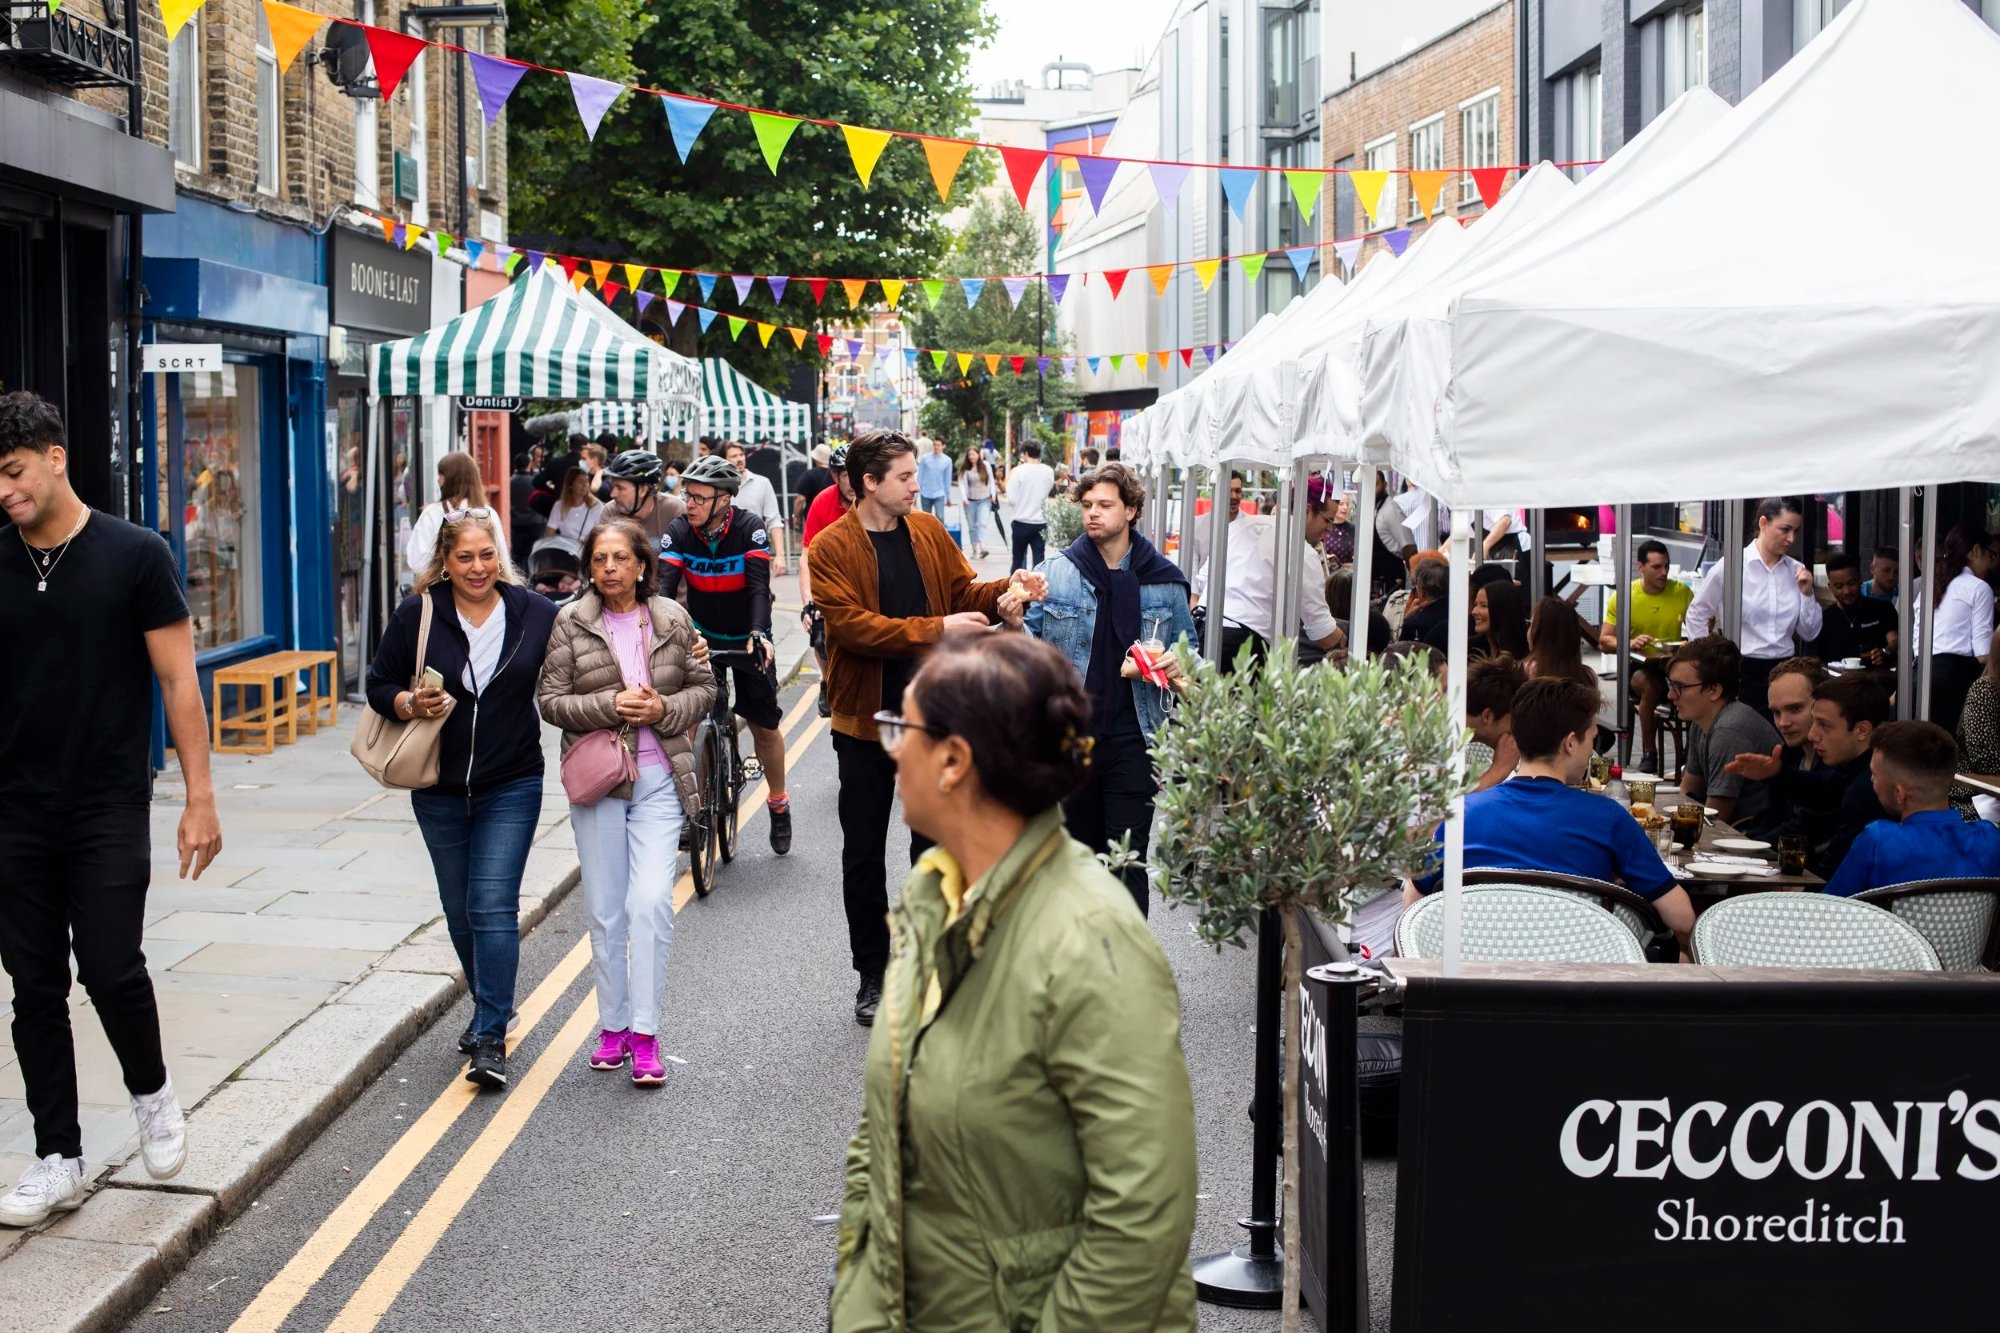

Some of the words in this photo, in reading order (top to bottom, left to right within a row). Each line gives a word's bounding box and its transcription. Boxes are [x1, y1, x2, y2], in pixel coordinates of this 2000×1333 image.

[351, 262, 388, 299] BOONE
[397, 274, 419, 305] LAST
[159, 358, 206, 368] SCRT
[465, 396, 513, 407] Dentist
[1559, 1089, 2000, 1181] CECCONI'S
[1654, 1198, 1907, 1243] Shoreditch
